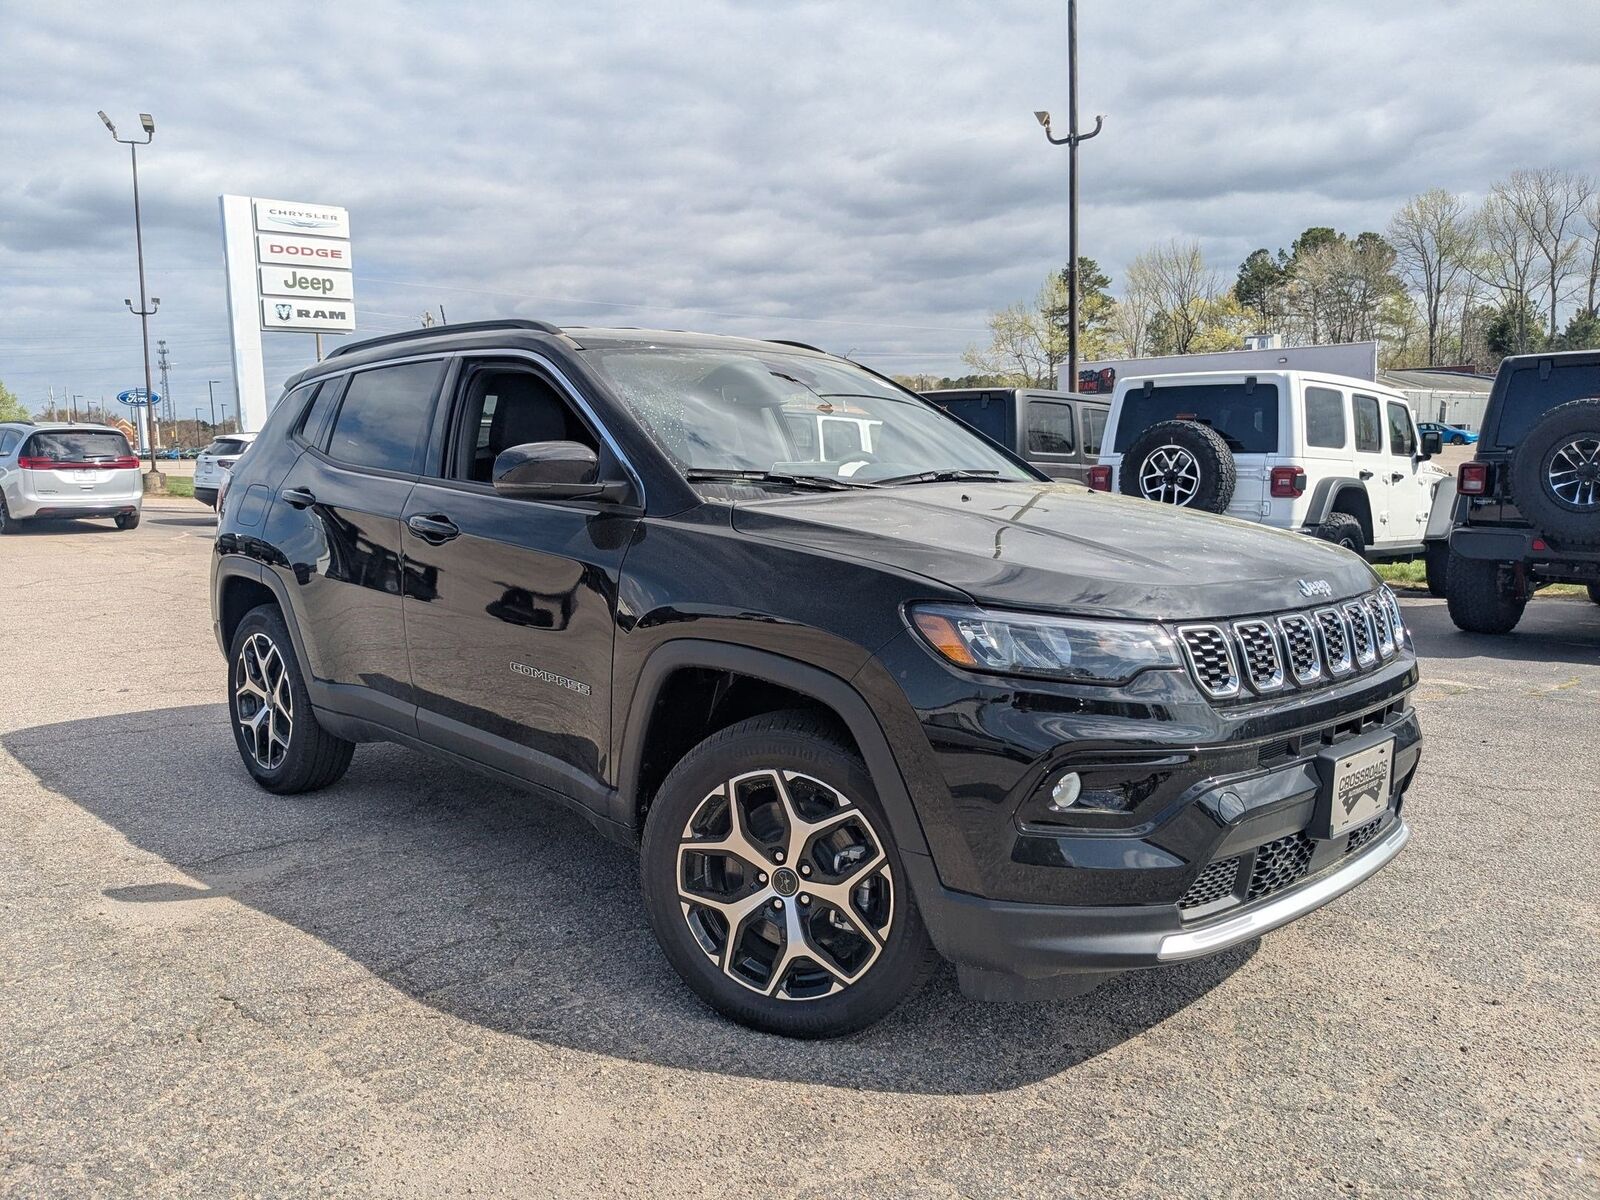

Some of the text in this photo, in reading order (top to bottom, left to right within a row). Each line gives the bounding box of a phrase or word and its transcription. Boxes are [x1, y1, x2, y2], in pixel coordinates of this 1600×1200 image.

[268, 208, 339, 221] CHRYSLER
[269, 244, 343, 259] DODGE
[283, 271, 334, 294] Jeep
[296, 309, 346, 320] RAM
[1297, 579, 1332, 597] Jeep
[509, 661, 591, 696] COMPASS
[1339, 759, 1388, 791] CROSSROADS
